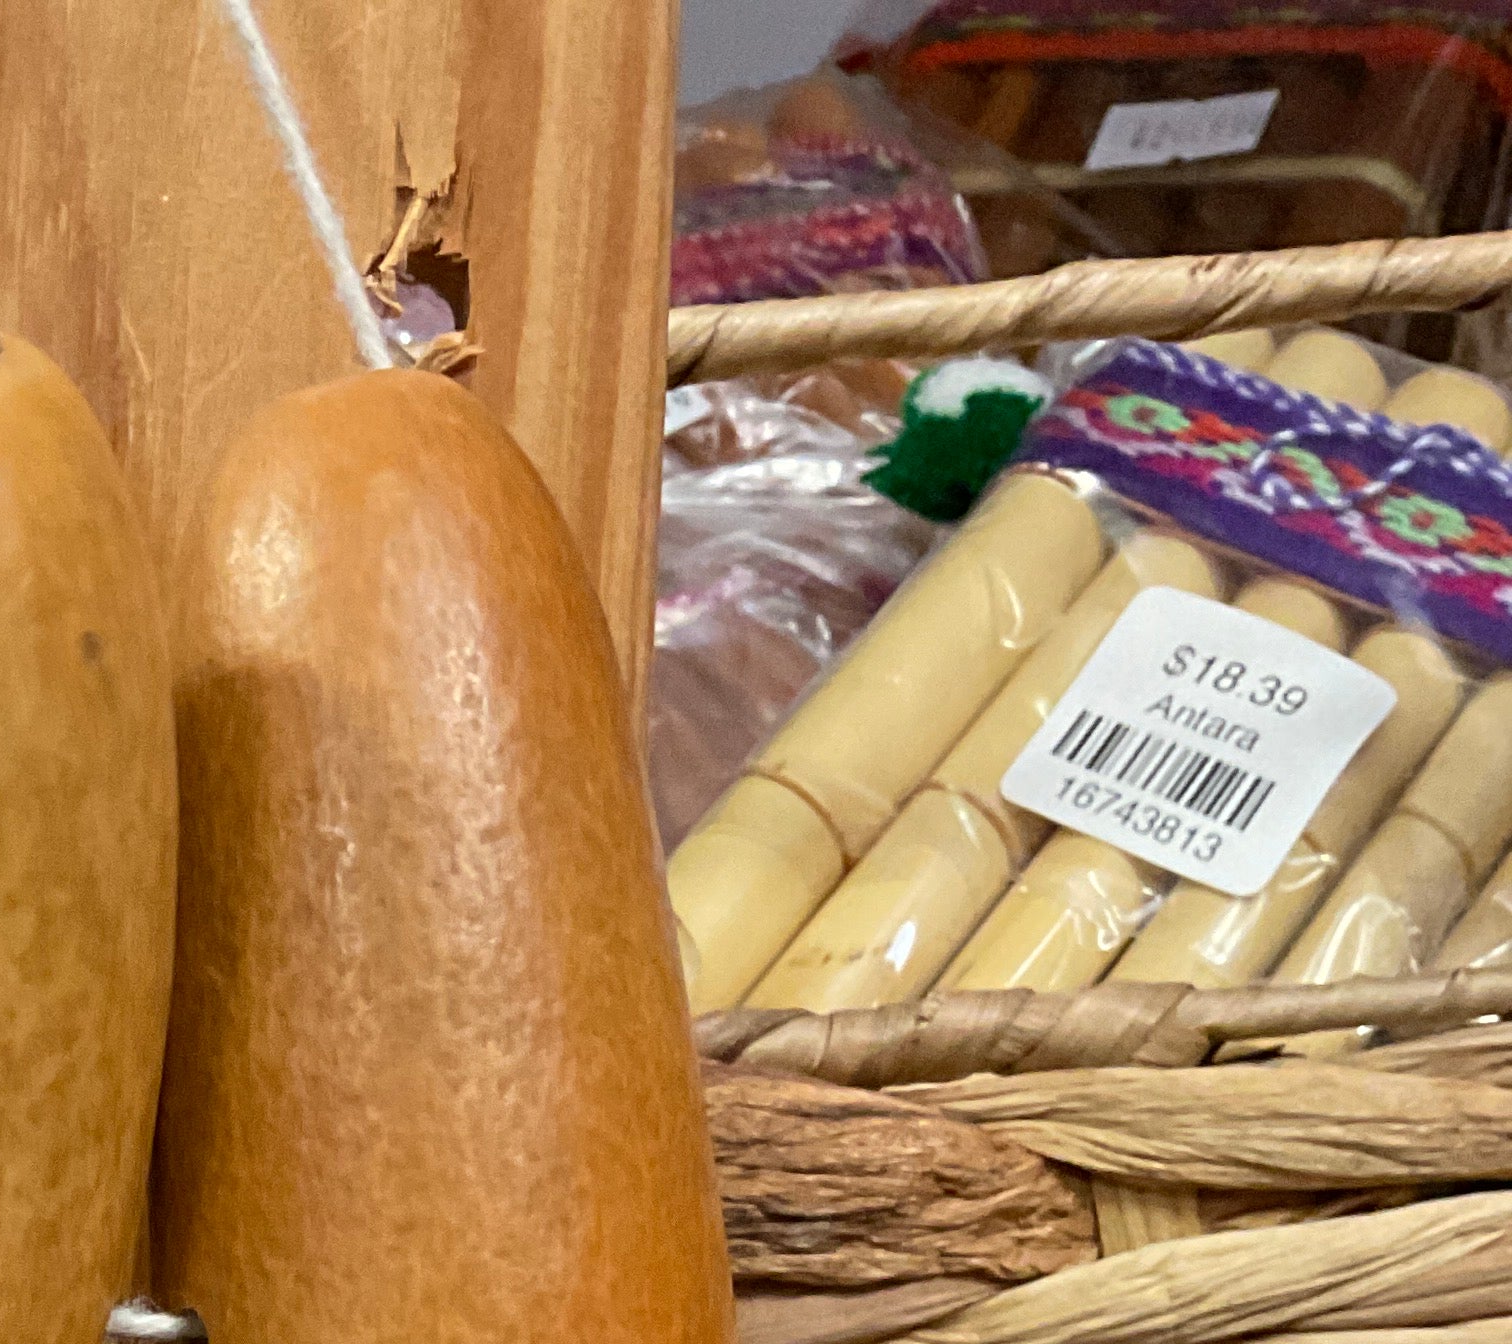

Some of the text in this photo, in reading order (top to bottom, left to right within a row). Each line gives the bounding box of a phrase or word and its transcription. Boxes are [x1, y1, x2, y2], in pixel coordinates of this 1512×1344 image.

[1161, 644, 1309, 716] $18.39
[1144, 693, 1262, 754] Antara
[1055, 775, 1224, 863] 16743813
